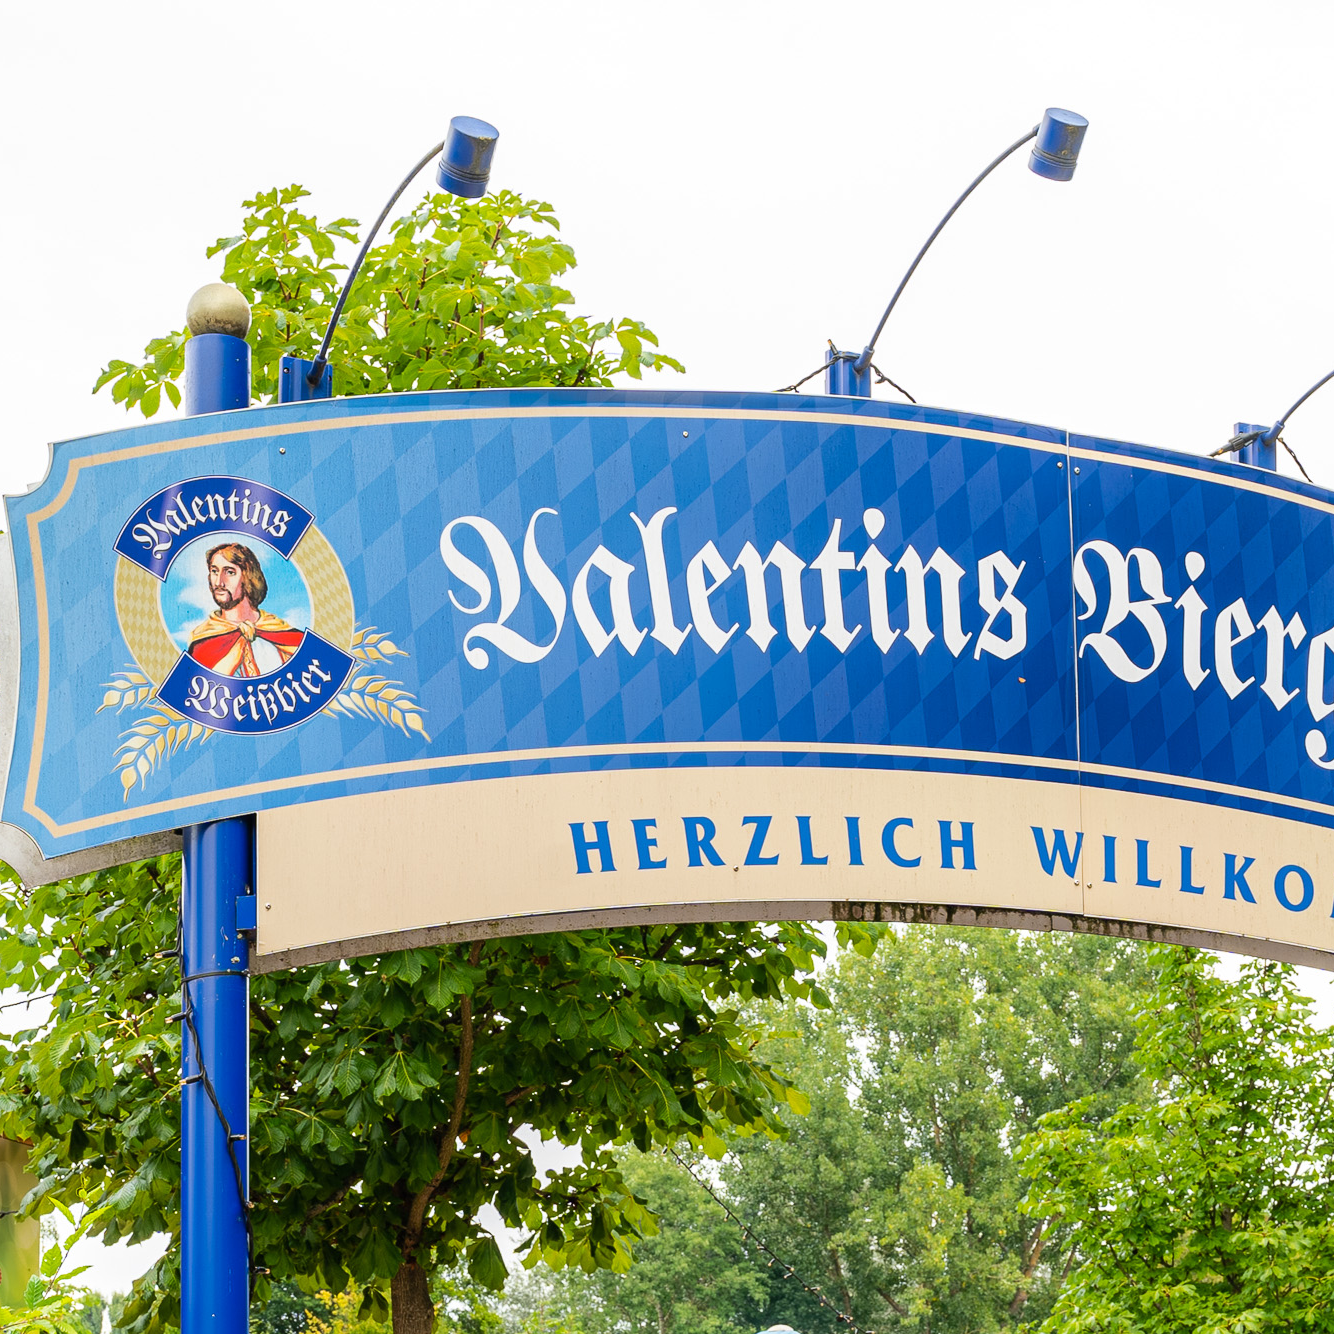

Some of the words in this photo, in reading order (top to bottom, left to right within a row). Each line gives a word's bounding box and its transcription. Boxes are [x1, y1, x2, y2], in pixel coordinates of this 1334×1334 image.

[132, 489, 292, 560] Valentins
[439, 507, 1027, 670] Valentins
[184, 659, 332, 725] Weißbier
[568, 815, 977, 874] HERZLICH
